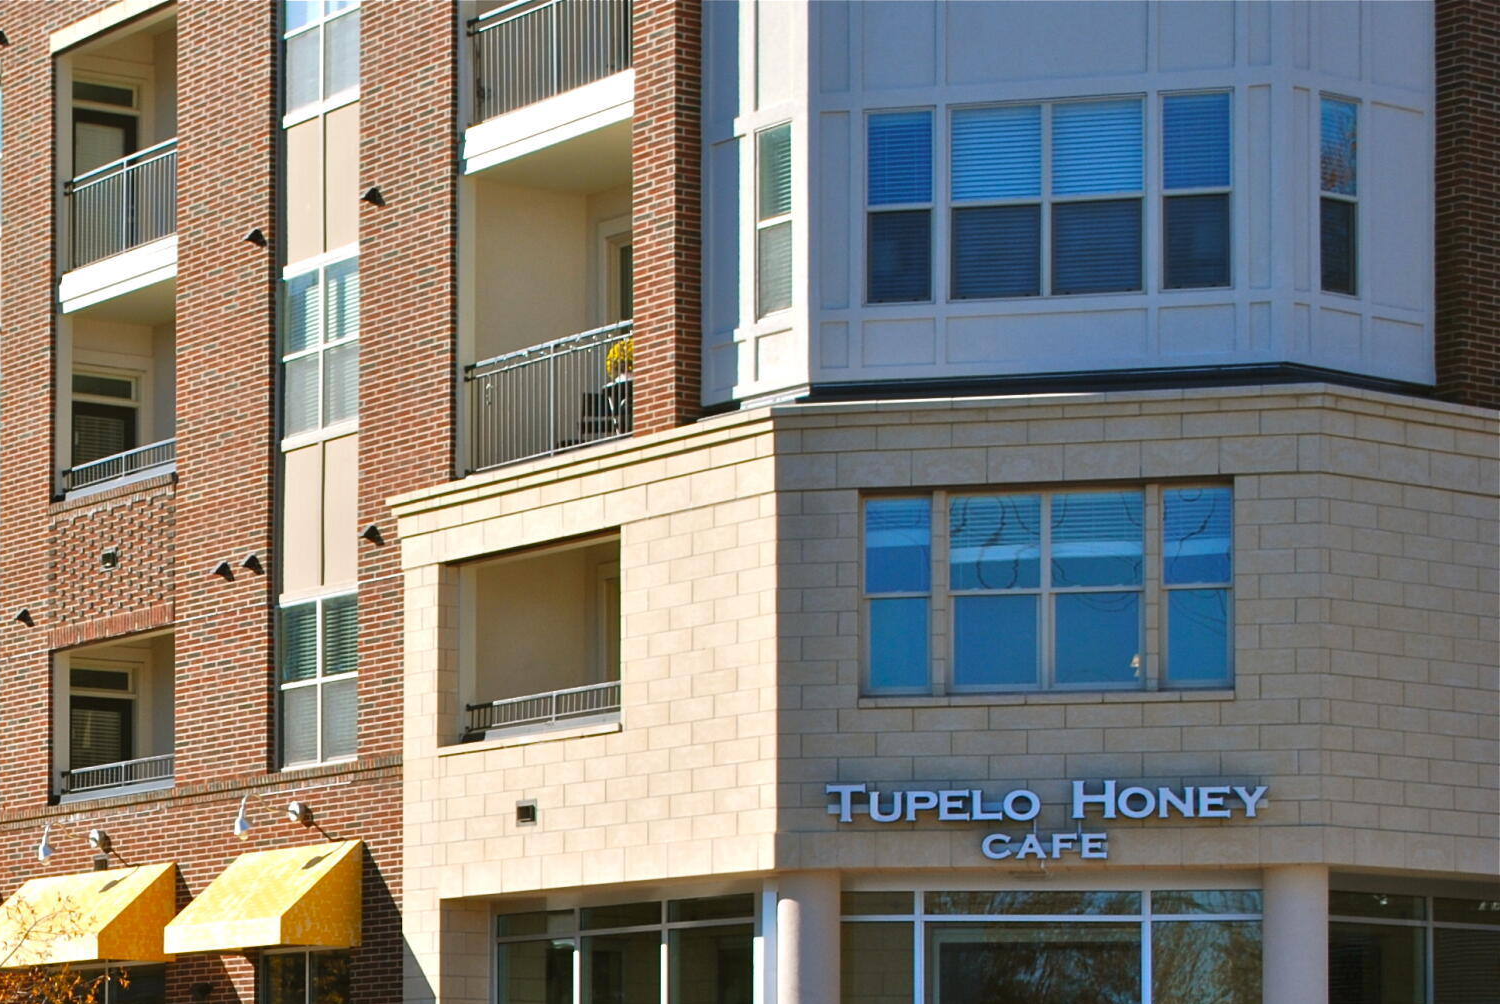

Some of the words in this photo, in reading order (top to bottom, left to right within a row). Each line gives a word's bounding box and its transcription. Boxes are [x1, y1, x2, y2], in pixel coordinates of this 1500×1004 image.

[826, 783, 1041, 822] TUPELO
[1072, 780, 1268, 819] HONEY
[981, 832, 1109, 860] CAFE
